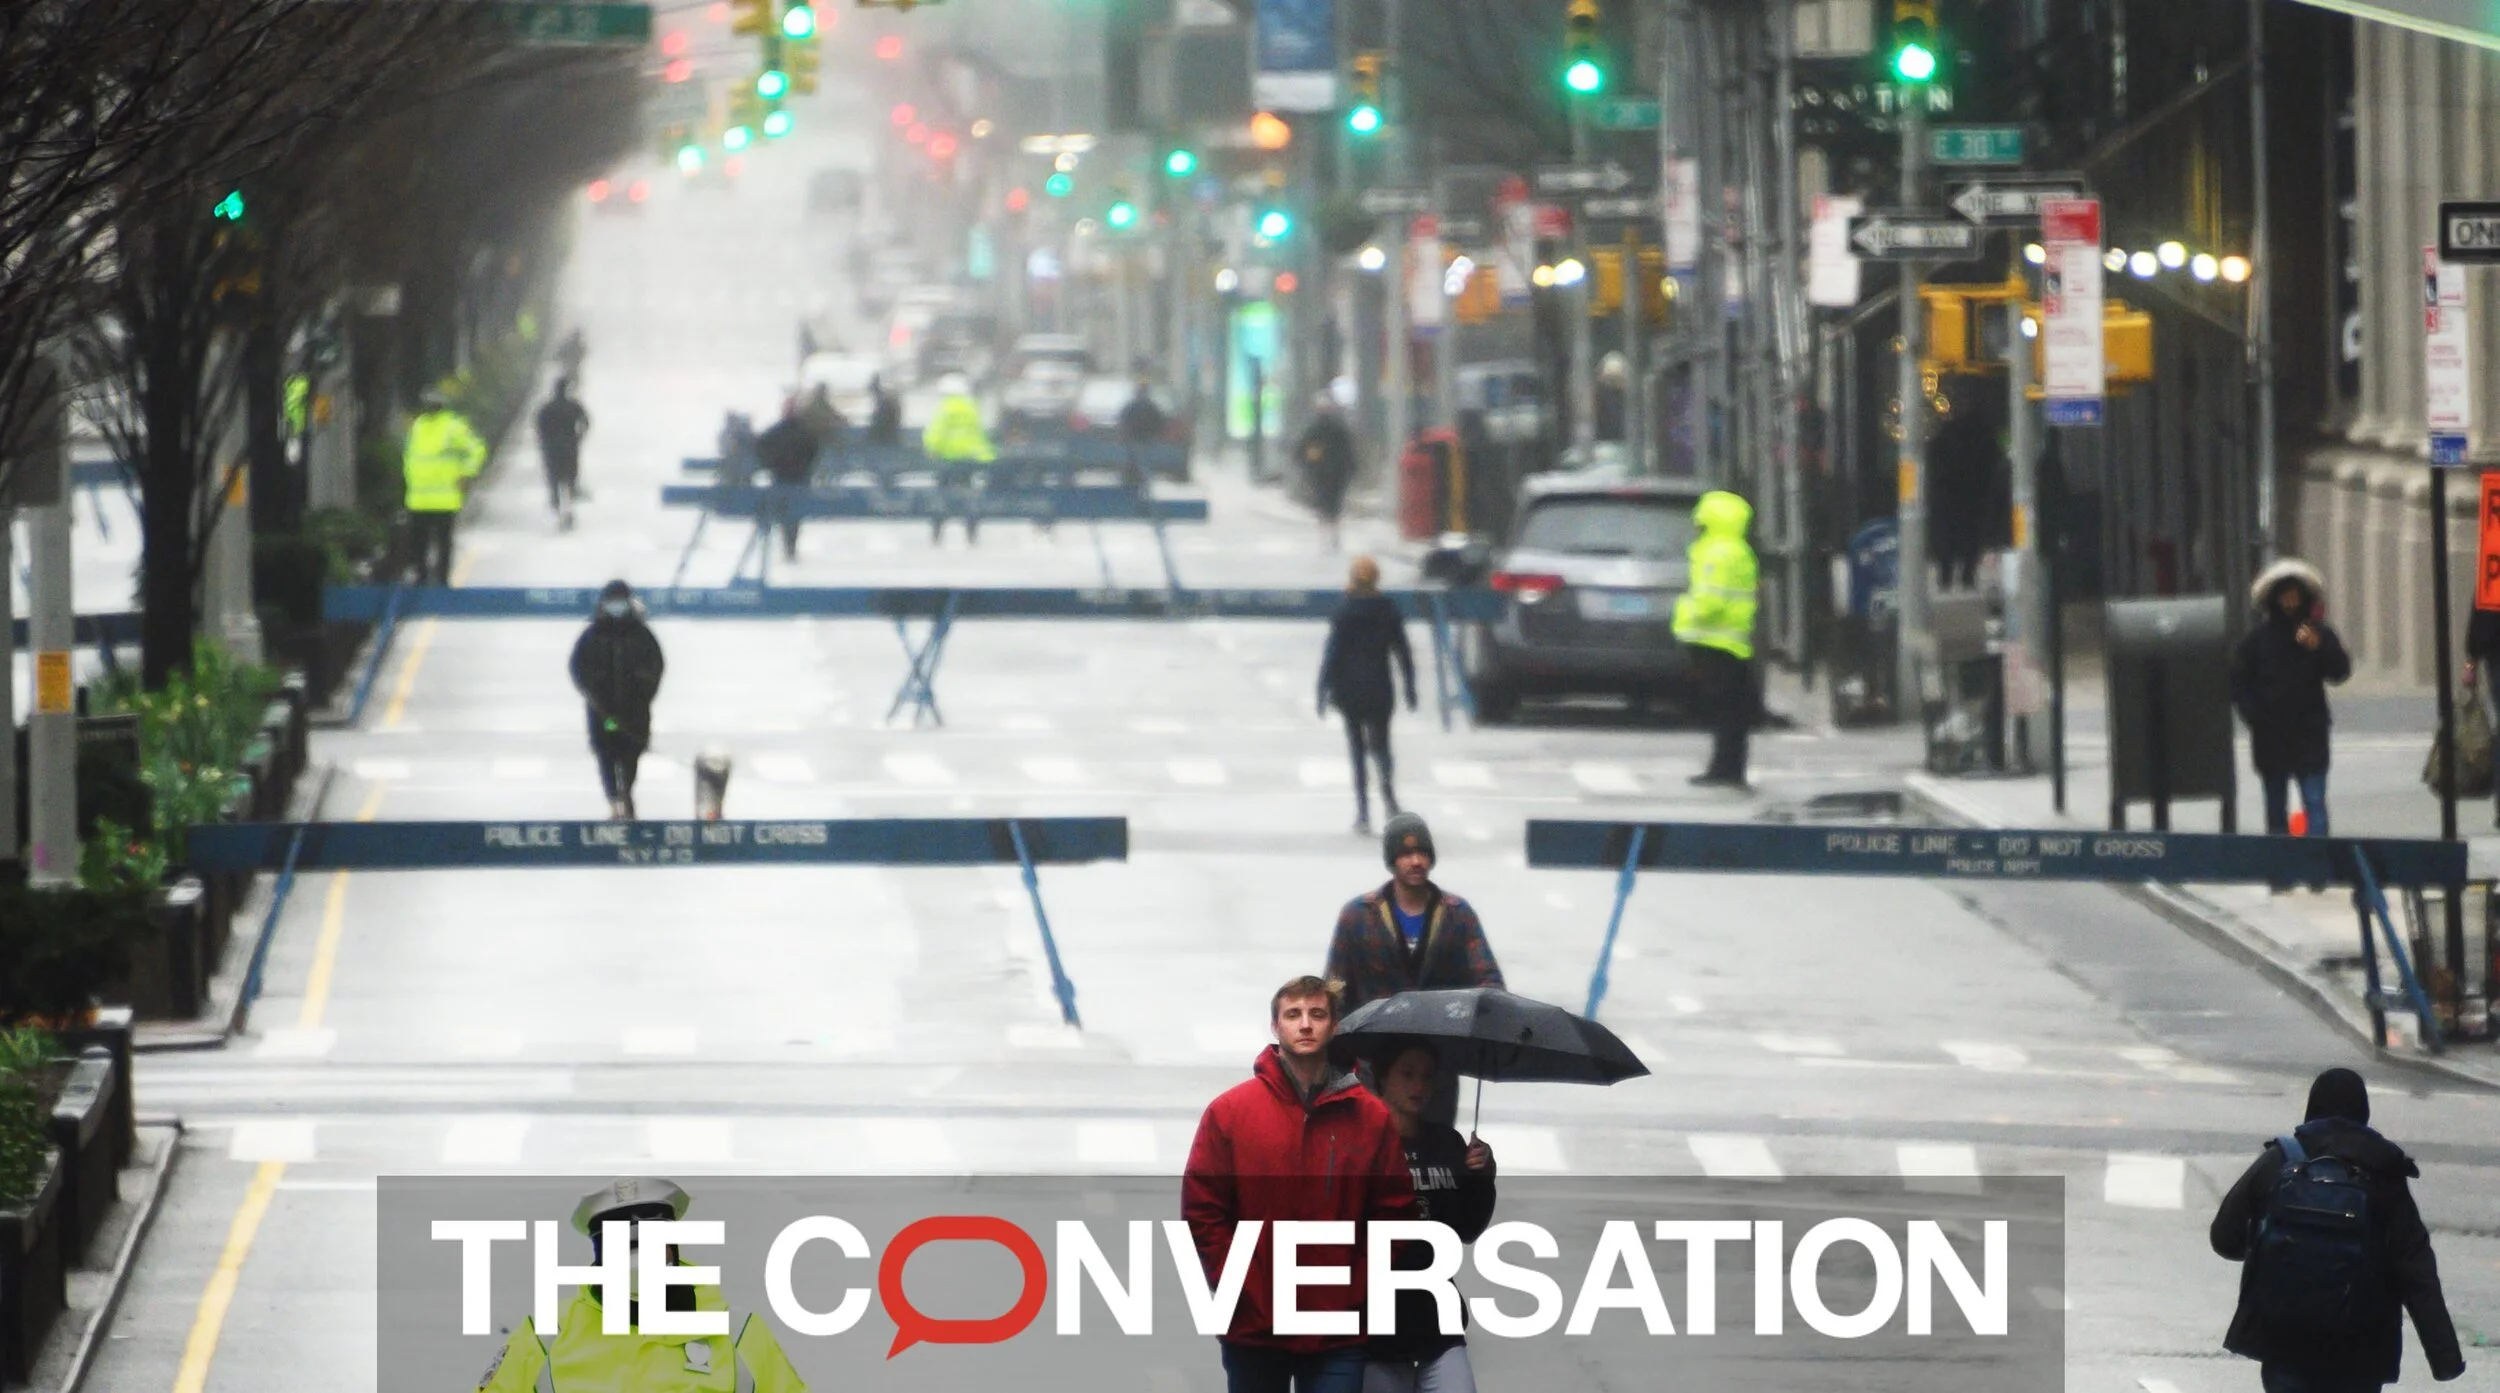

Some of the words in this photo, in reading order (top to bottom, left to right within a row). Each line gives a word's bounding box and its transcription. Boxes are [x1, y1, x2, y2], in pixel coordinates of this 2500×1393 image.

[484, 825, 563, 846] POLICE
[580, 825, 628, 845] LINE
[665, 825, 693, 845] DO
[702, 825, 746, 844] NOT
[754, 825, 827, 844] CROSS
[1826, 834, 1899, 854] POLICE
[1911, 836, 1956, 854] LINE
[1998, 837, 2031, 855] DO
[2039, 837, 2082, 856] NOT
[2093, 839, 2165, 858] CROSS
